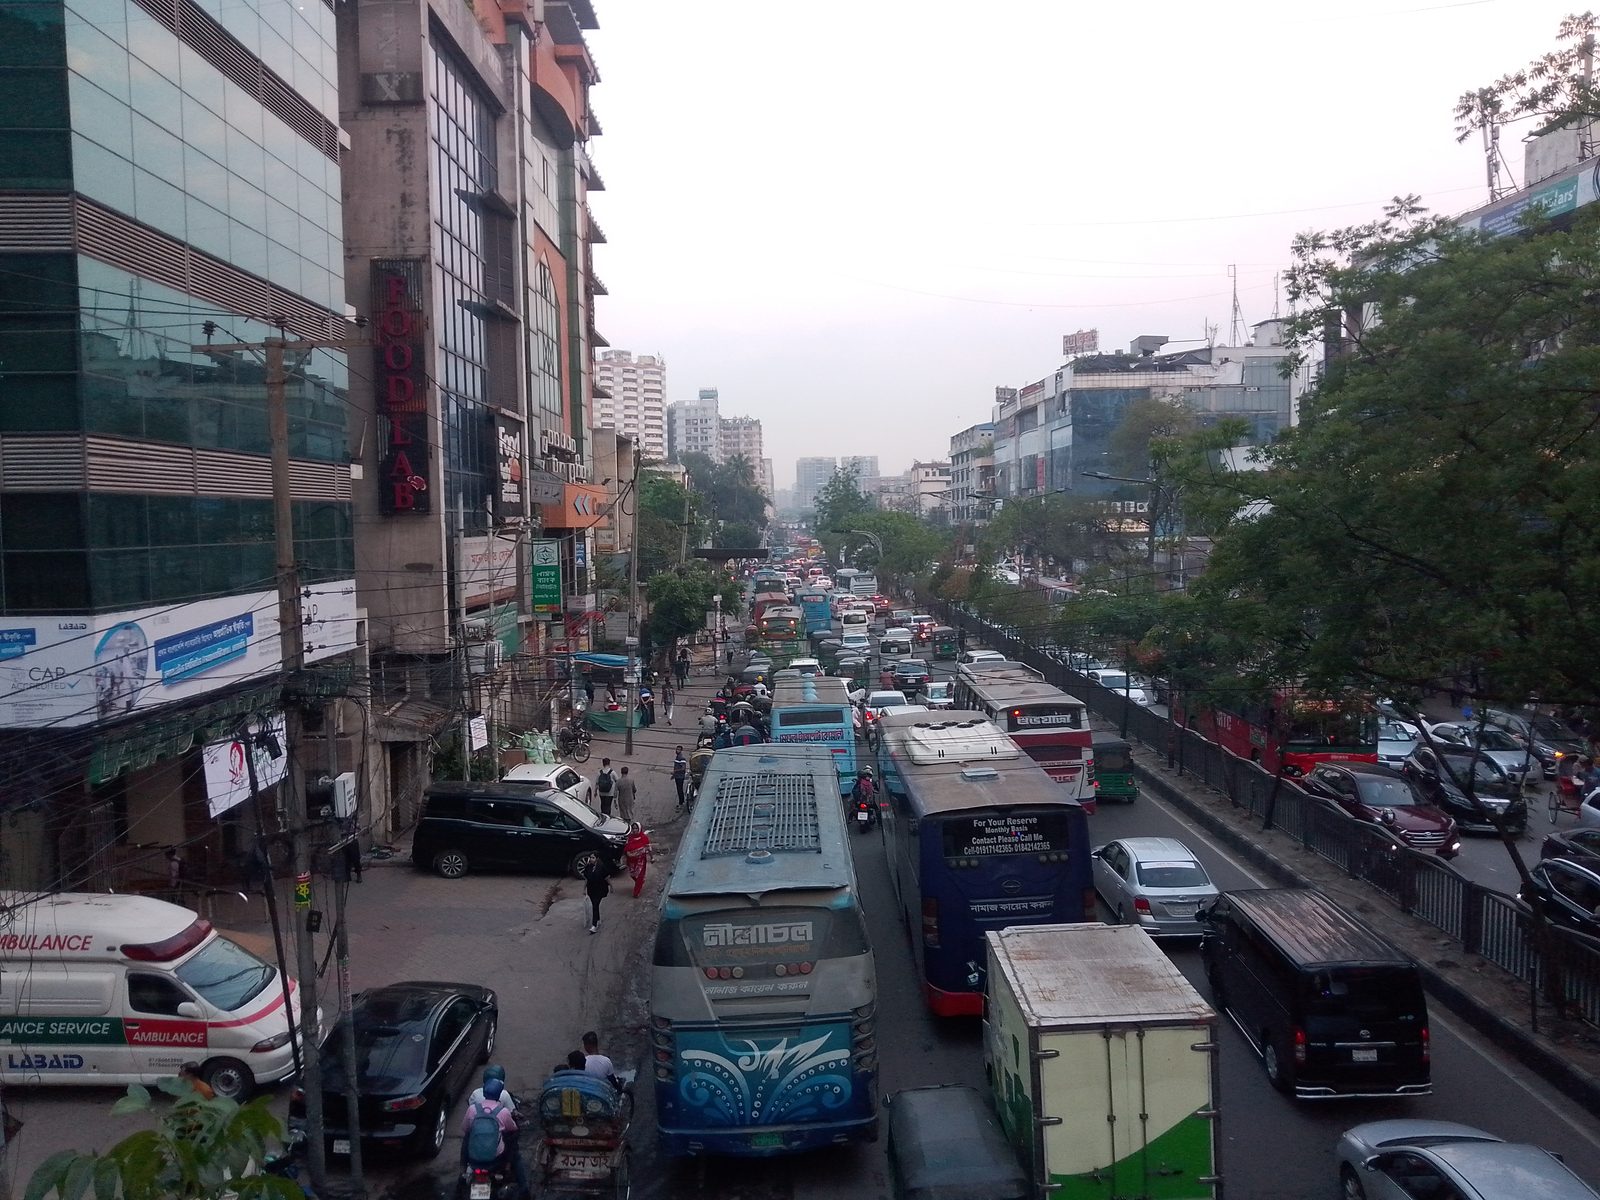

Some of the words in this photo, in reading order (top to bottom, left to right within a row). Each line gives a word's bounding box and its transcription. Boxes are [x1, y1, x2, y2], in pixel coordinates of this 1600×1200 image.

[28, 667, 66, 681] CAP
[11, 682, 66, 690] ACCREDITED
[987, 818, 1005, 826] Your
[1006, 817, 1038, 825] Reserve
[985, 826, 1010, 834] Monthly
[971, 836, 997, 845] Contact
[997, 835, 1019, 843] Please
[1020, 833, 1033, 842] Call
[1033, 833, 1043, 841] Me
[969, 904, 998, 913] নামাজ
[703, 922, 813, 946] নীলাচল
[49, 1022, 111, 1034] SERVICE
[132, 1032, 204, 1043] AMBULANCE
[8, 1054, 84, 1069] LABAID
